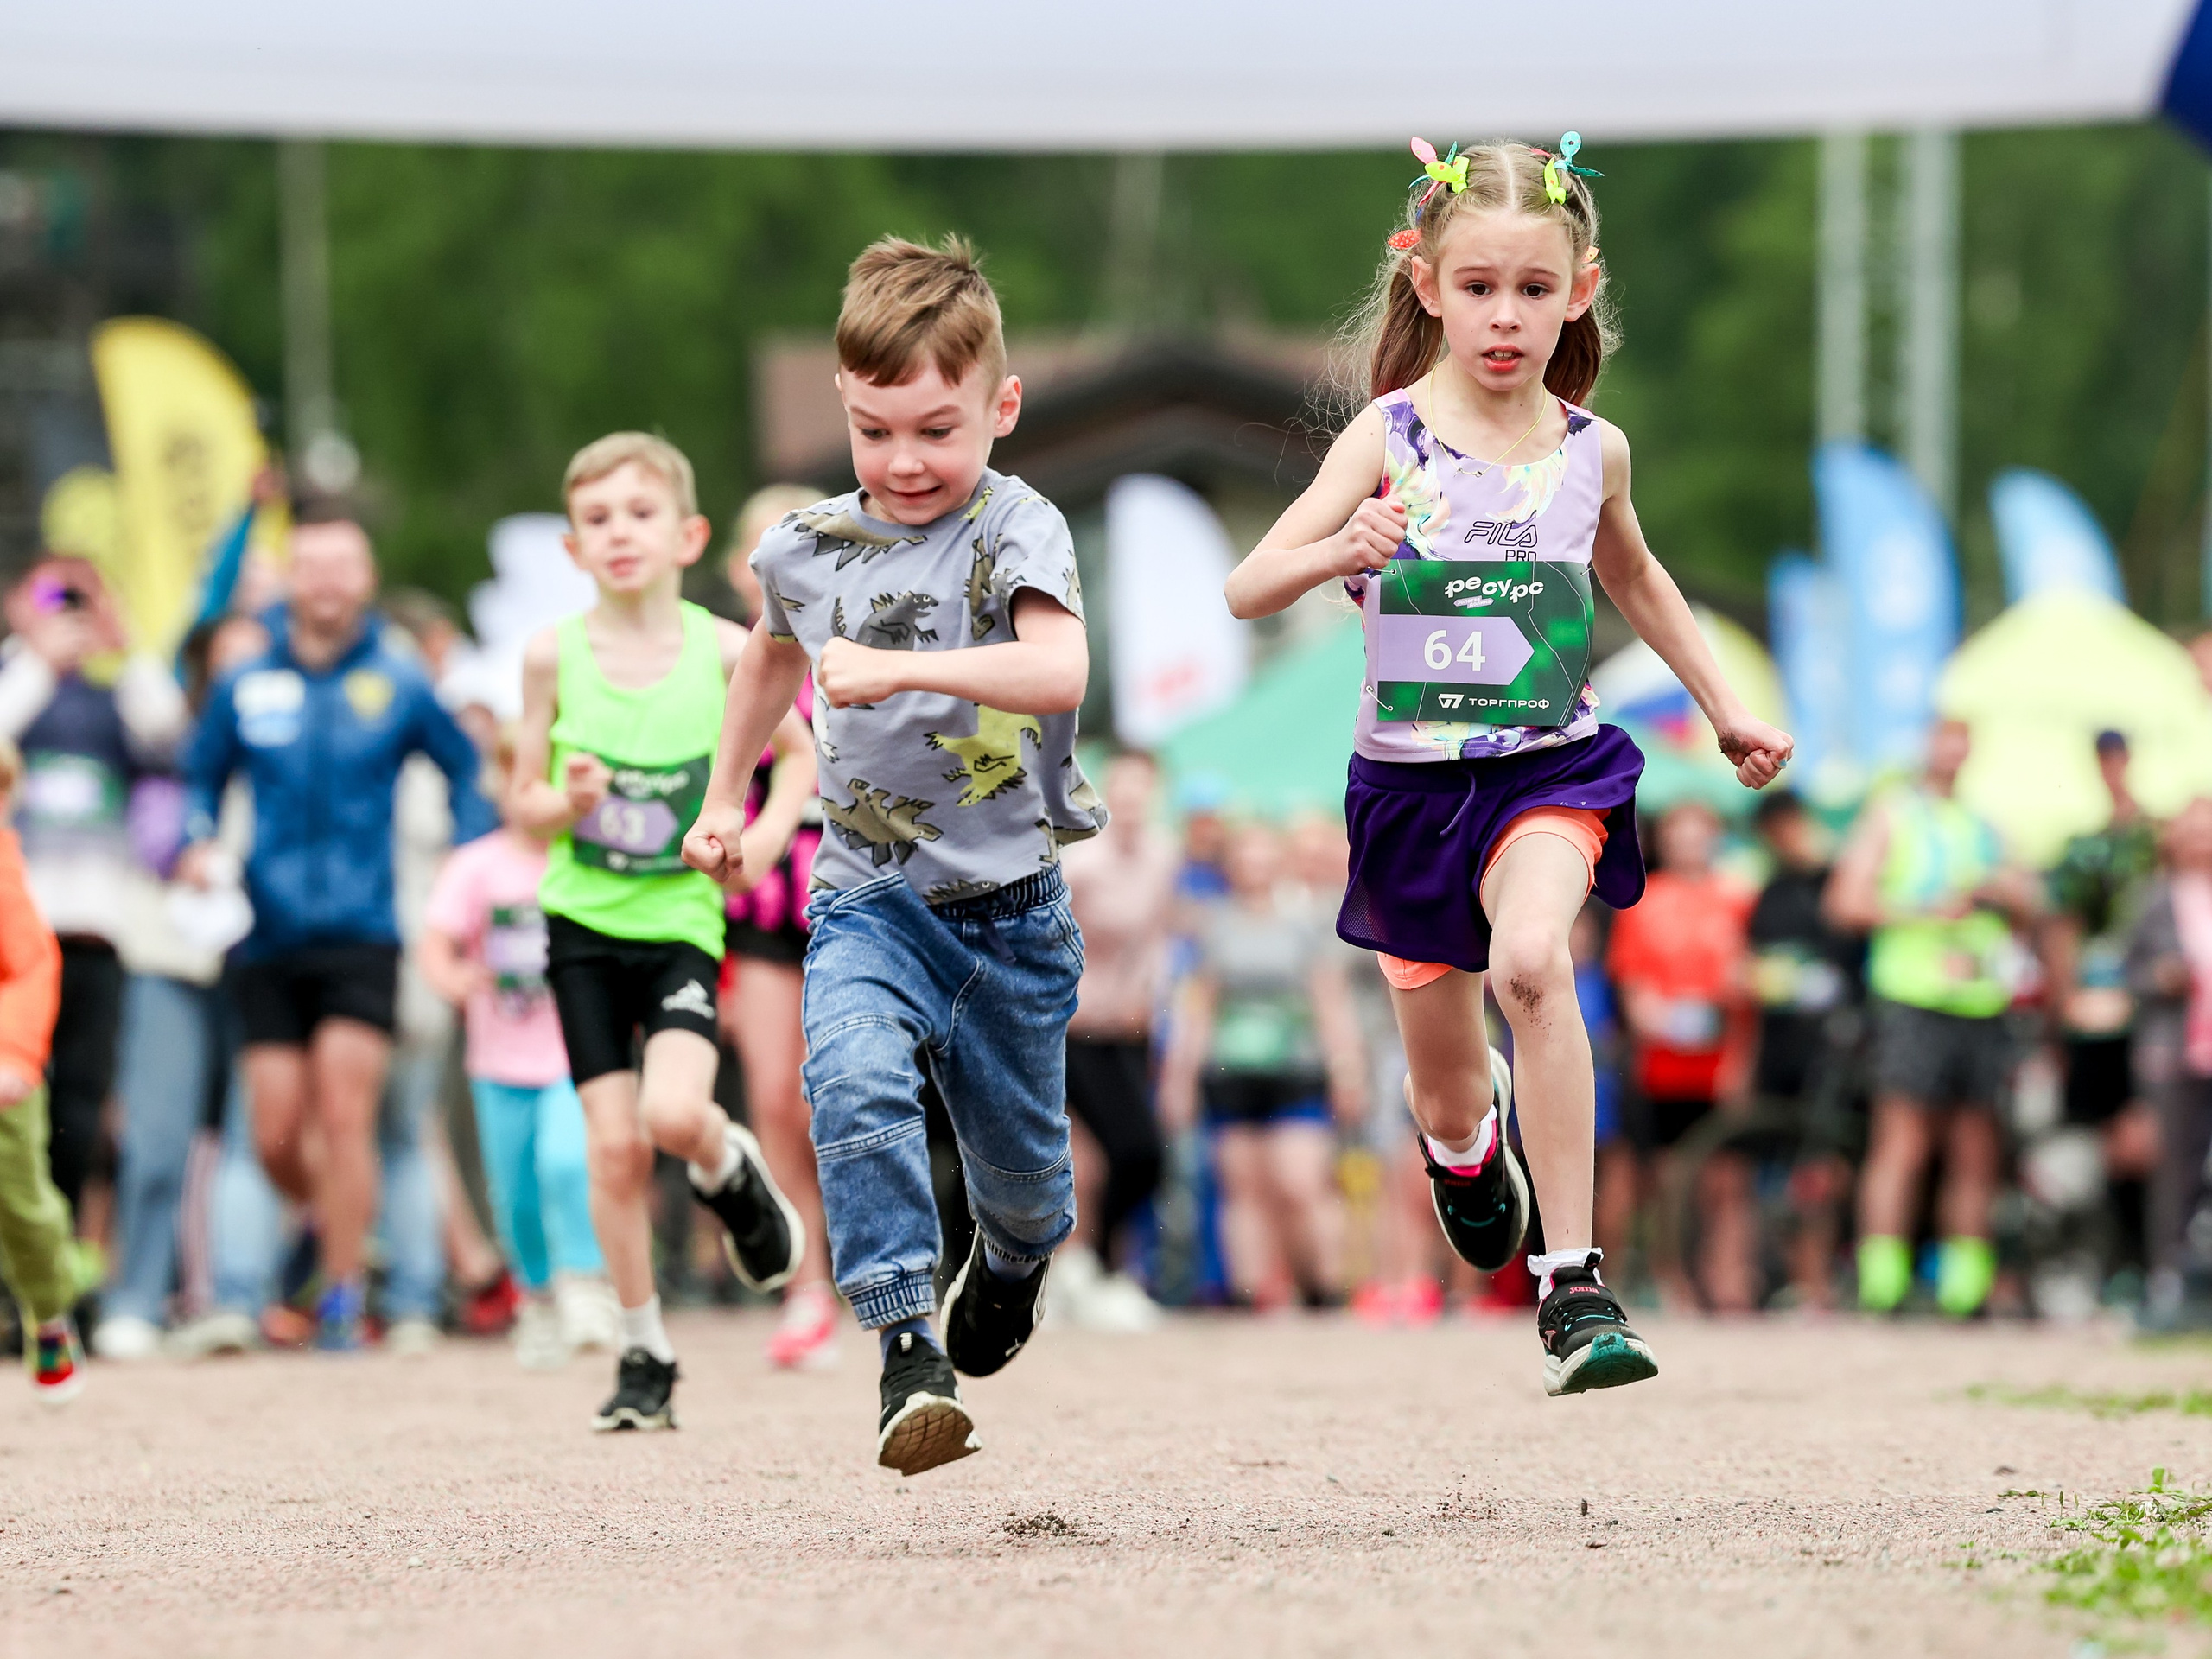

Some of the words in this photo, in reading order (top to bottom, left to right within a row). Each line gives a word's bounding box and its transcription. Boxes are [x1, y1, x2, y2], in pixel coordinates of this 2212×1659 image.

[1464, 520, 1537, 548] FILA
[1444, 576, 1544, 603] ресурс
[1423, 629, 1486, 671] 64
[1468, 697, 1550, 709] ТОРГПРОФ
